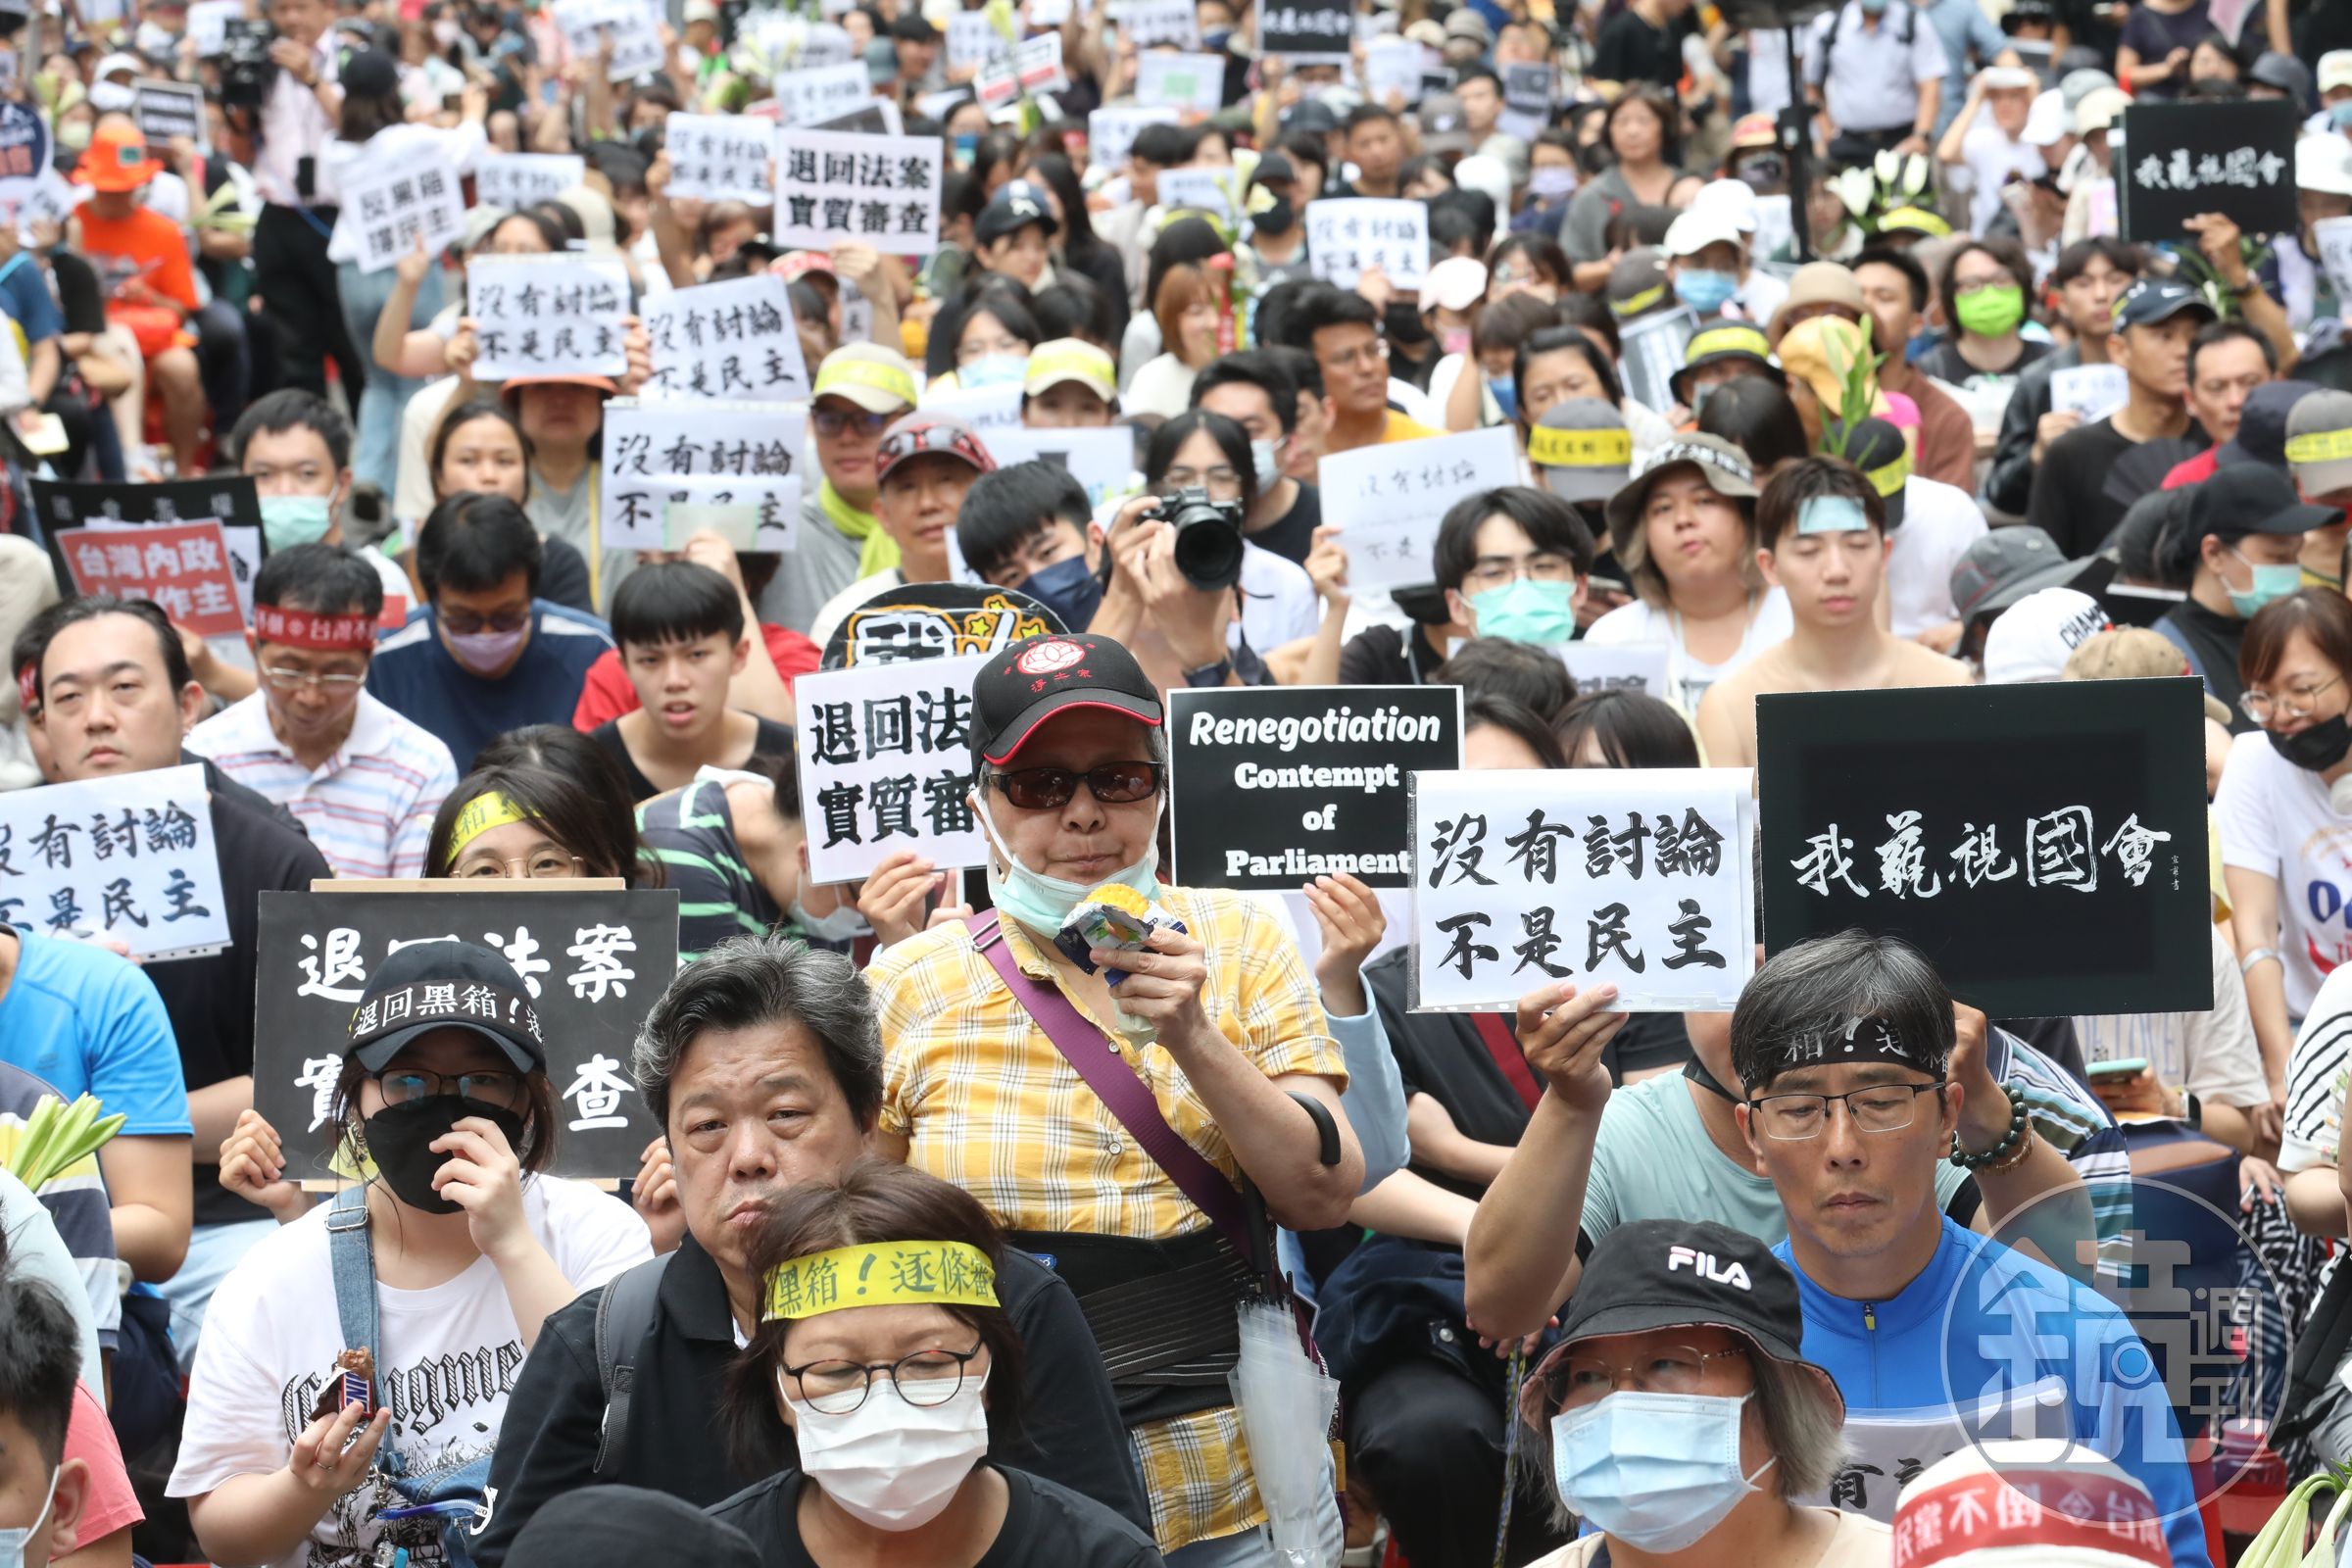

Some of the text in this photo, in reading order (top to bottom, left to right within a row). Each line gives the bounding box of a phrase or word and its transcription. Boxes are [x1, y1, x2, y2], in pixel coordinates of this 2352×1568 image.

[786, 147, 931, 190] 退回法案
[786, 193, 929, 235] 實質審查
[476, 283, 620, 318] 沒有討論
[478, 325, 621, 364] 不是民主
[648, 299, 783, 352] 沒有討論
[651, 349, 796, 399] 不是民主
[612, 434, 794, 478] 沒有討論
[614, 490, 787, 532] 不主
[1189, 705, 1441, 753] Renegotiation
[1234, 761, 1399, 794] Contempt
[1302, 803, 1337, 832] of
[1225, 848, 1408, 877] Parliament
[1428, 807, 1725, 889] 沒有討論
[1435, 898, 1727, 980] 不是民主
[297, 922, 637, 1004] 退法案
[1668, 1246, 1752, 1291] FILA
